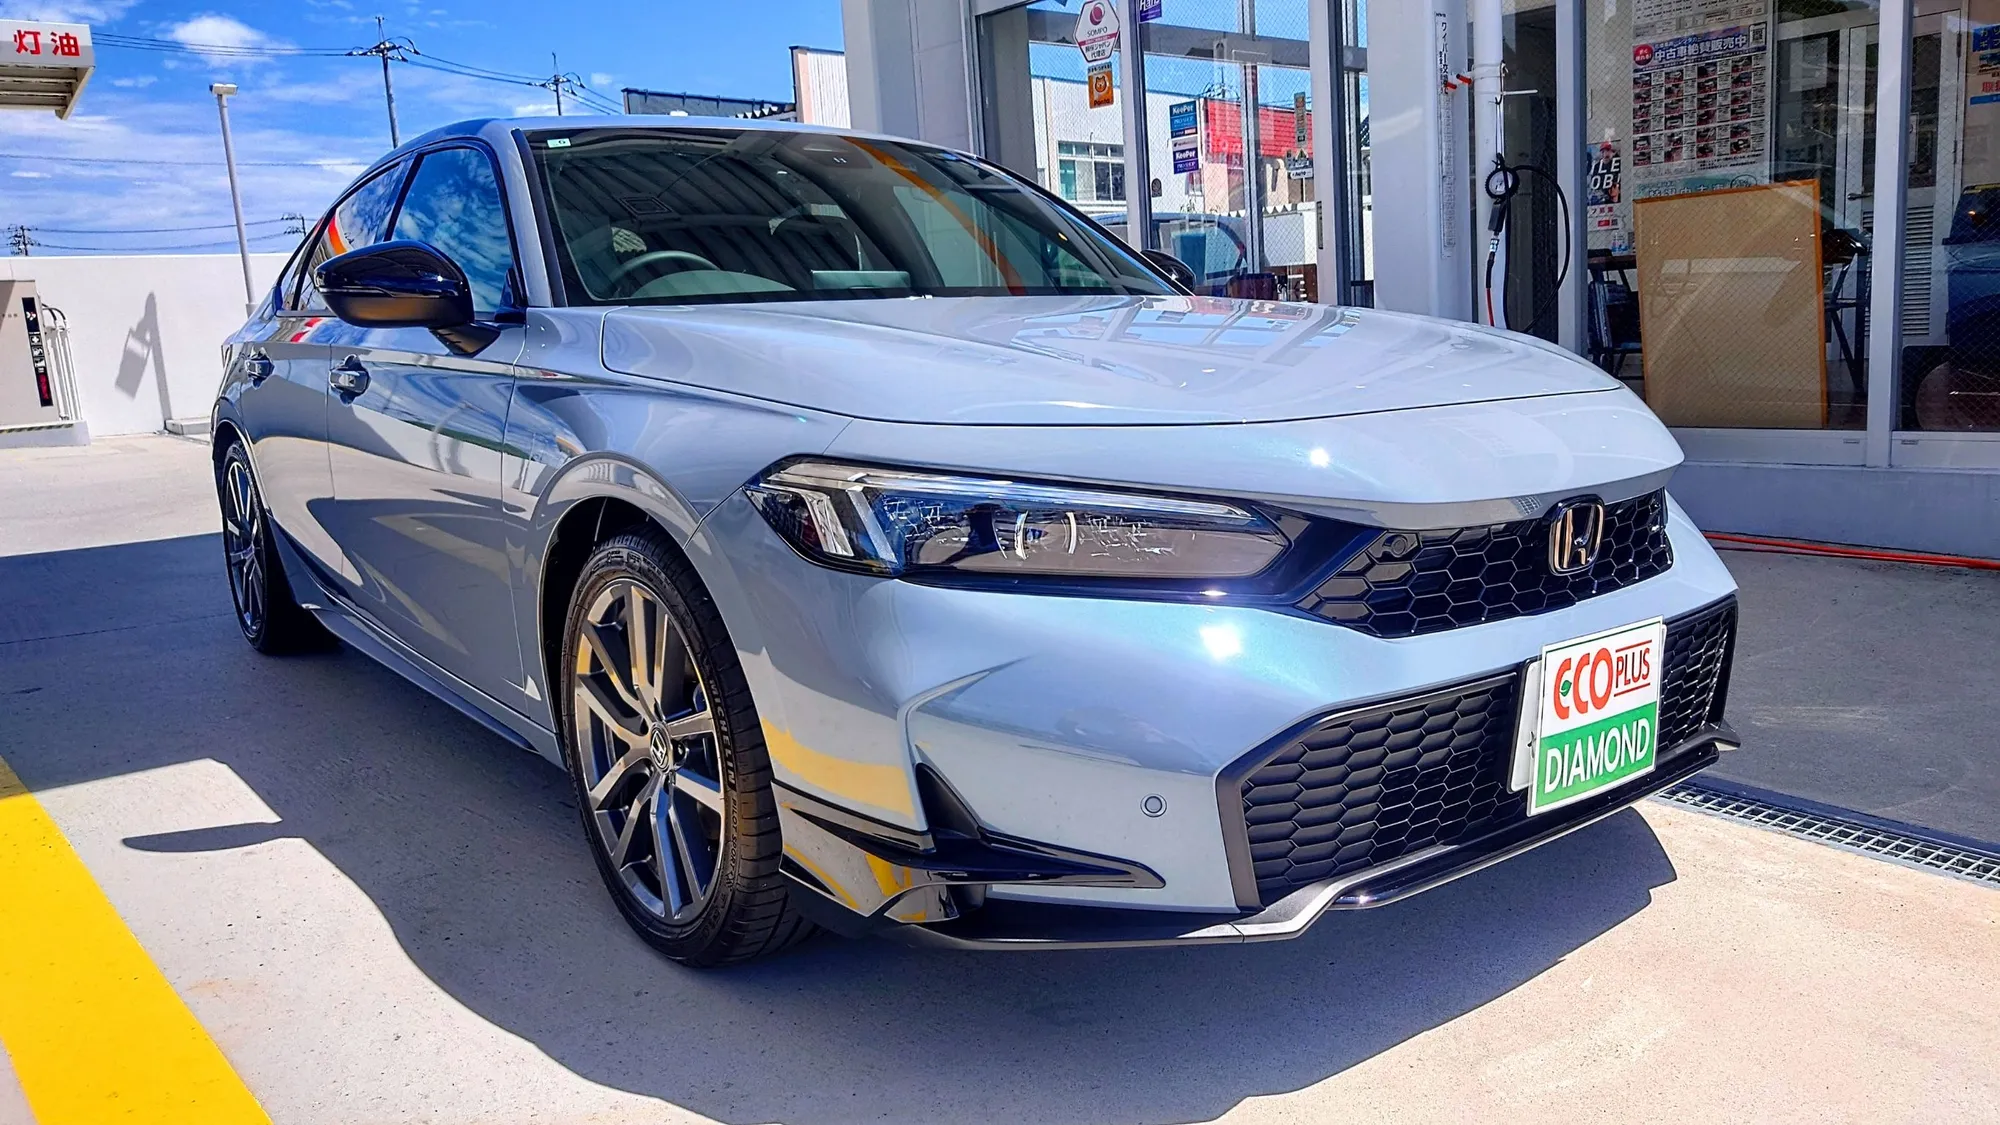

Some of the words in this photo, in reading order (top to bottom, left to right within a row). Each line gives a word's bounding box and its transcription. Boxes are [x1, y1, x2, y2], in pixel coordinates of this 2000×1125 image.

[13, 29, 80, 57] 灯油
[1087, 26, 1107, 38] SOMPO
[1173, 105, 1193, 114] KeePer
[1176, 151, 1196, 160] KeePer
[1615, 648, 1650, 689] PLUS
[709, 679, 736, 785] MICHELIN
[1544, 718, 1650, 794] DIAMOND
[731, 797, 739, 833] PILOT
[729, 835, 739, 871] SPORT
